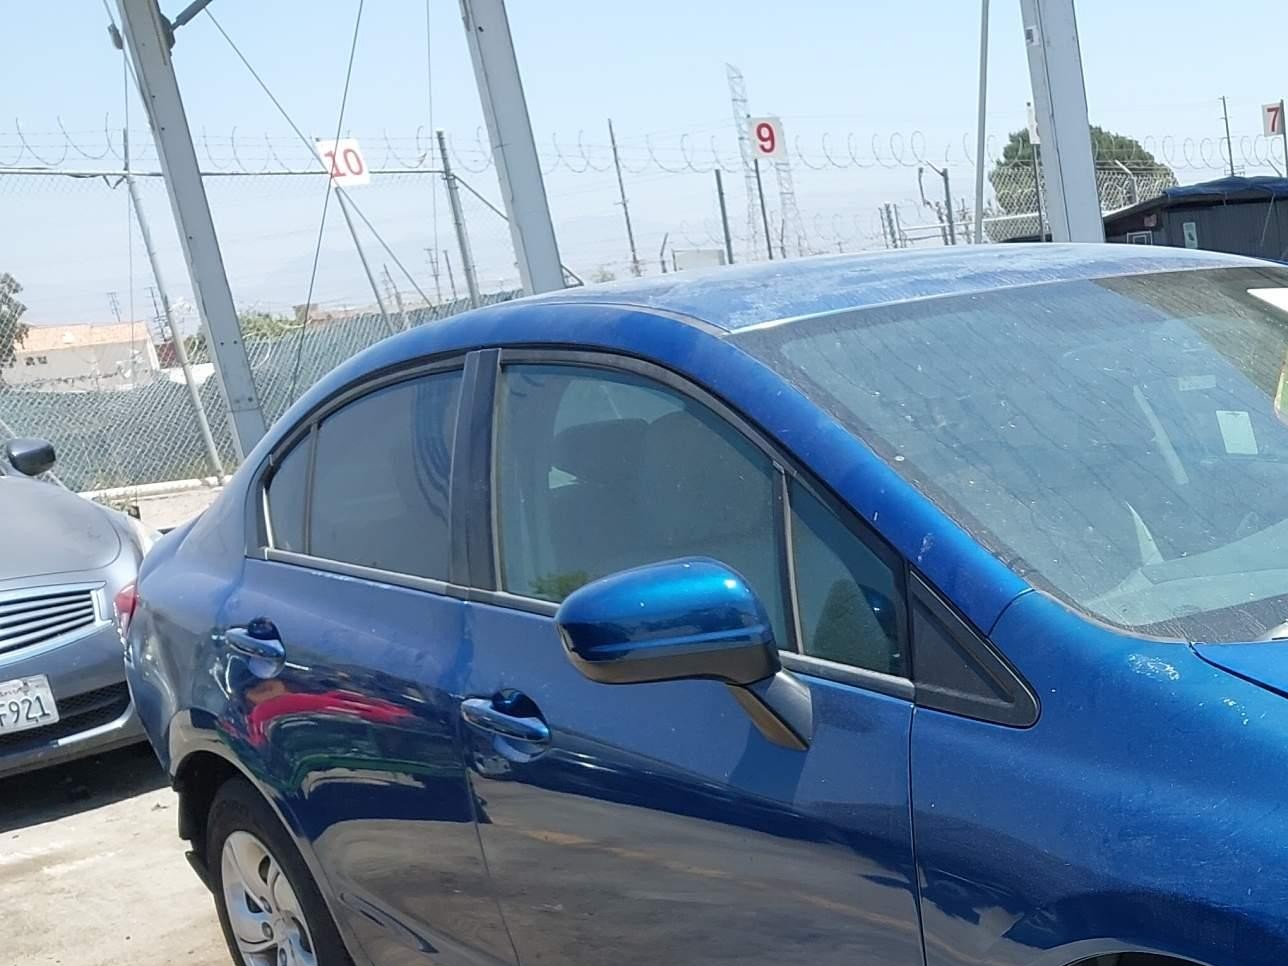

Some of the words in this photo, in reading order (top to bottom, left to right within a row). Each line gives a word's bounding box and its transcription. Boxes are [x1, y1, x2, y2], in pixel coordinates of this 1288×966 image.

[1267, 107, 1280, 132] 7
[756, 122, 775, 153] 9
[324, 148, 363, 178] 10
